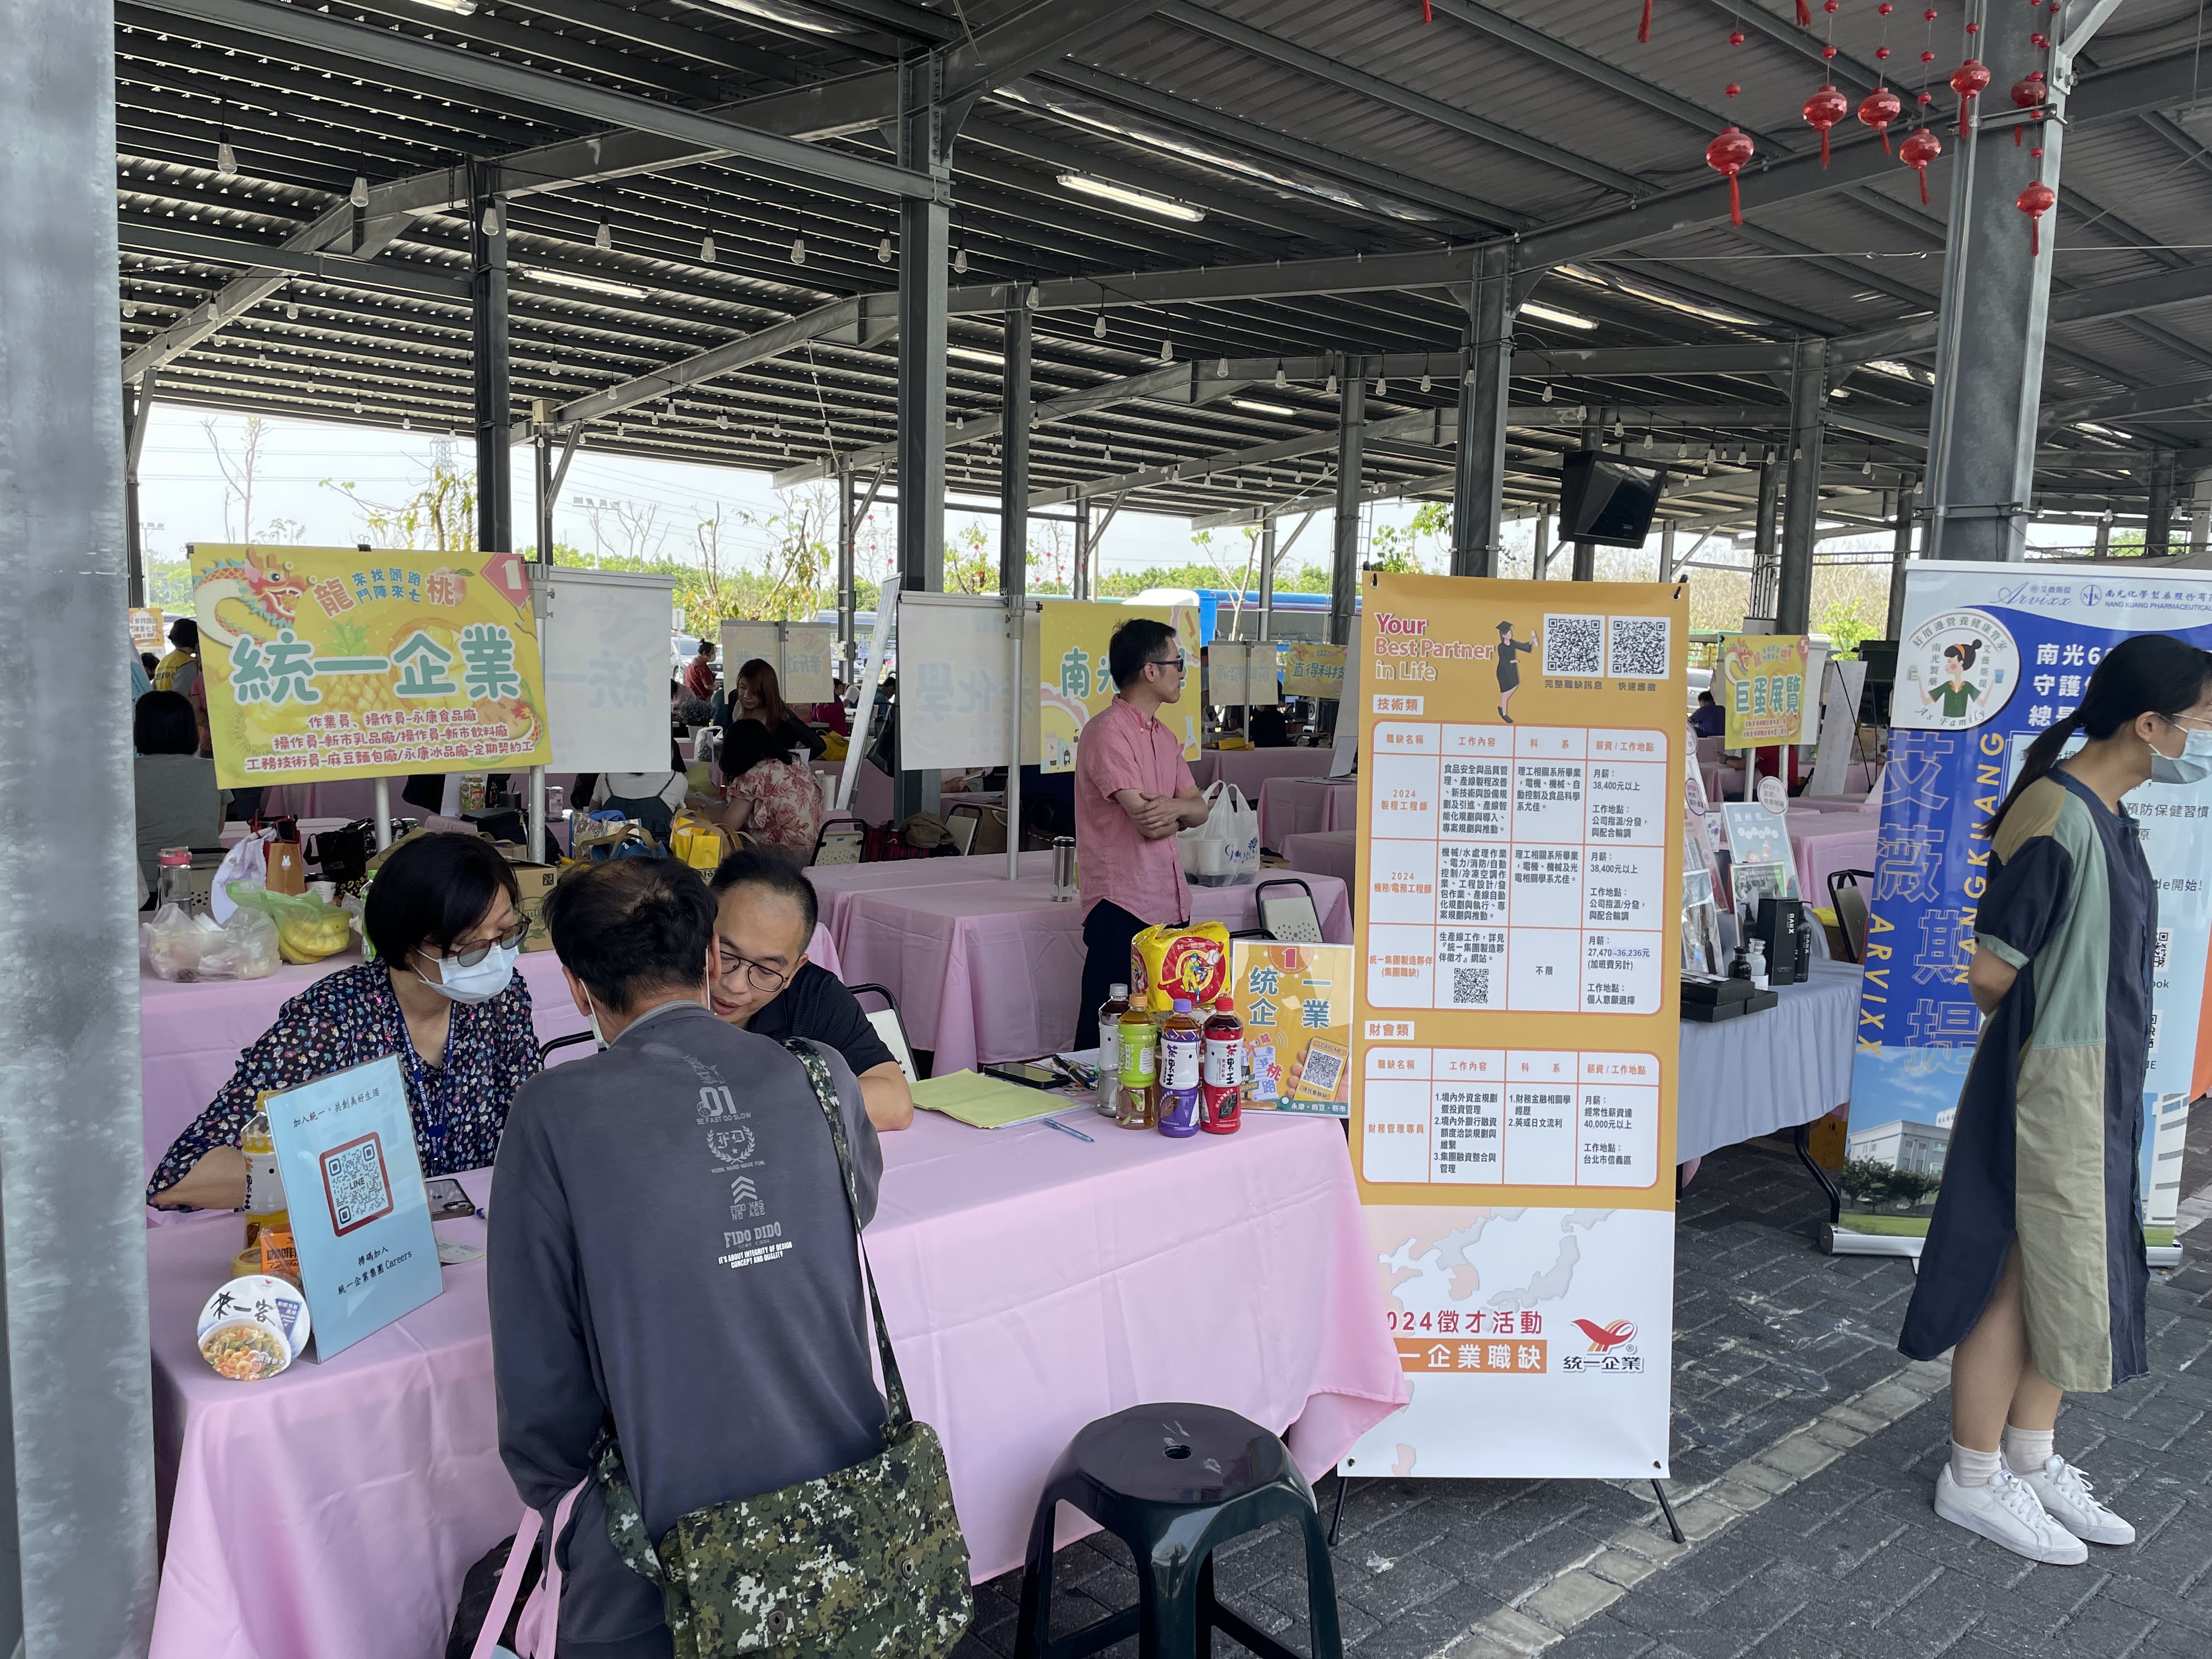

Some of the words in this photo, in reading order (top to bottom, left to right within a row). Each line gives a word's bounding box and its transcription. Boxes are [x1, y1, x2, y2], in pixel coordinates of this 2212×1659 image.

[352, 568, 421, 587] 來找頭路
[501, 560, 520, 590] 1
[427, 575, 455, 606] 桃
[313, 577, 355, 618] 龍
[2149, 603, 2212, 612] PHARMACEUTICAL
[1375, 613, 1428, 635] Your
[1374, 637, 1417, 657] Best
[1420, 641, 1494, 660] Partner
[1801, 639, 1809, 653] 5
[230, 625, 521, 703] 統一企業
[1928, 643, 1942, 686] 南光製藥
[1375, 661, 1395, 680] in
[1398, 662, 1437, 681] Life
[1544, 680, 1602, 690] 完整職缺訊息
[1618, 681, 1656, 692] 快速應徵
[2033, 674, 2092, 697] 守護
[1736, 675, 1801, 714] 巨蛋展覽
[1378, 697, 1418, 712] 技術類
[308, 710, 477, 730] 作業員、操作員-永康食品廠
[1386, 733, 1424, 745] 職缺名稱
[1458, 736, 1496, 747] 工作內容
[1444, 764, 1508, 775] 食品安全與品質管
[1517, 767, 1581, 778] 理工相關系所畢業
[1593, 769, 1615, 779] 月薪：
[1443, 776, 1507, 787] 理、產線製程改善
[1593, 781, 1640, 792] 38,400元以上
[1392, 789, 1417, 799] 2024
[1446, 787, 1507, 799] 、新技術與設備規
[1517, 791, 1580, 802] 動控制及食品科學
[1381, 800, 1427, 812] 製程工程師
[1443, 799, 1507, 811] 劃及引進、產線智
[1516, 802, 1547, 812] 系尤佳。
[1593, 804, 1629, 815] 工作地點：
[1443, 811, 1504, 822] 能化規劃與導入、
[1442, 823, 1504, 834] 專案規劃與推動。
[1592, 827, 1632, 838] 與配合輪調
[1441, 848, 1507, 859] 機械/水處理作業
[1515, 850, 1578, 861] 理工相關系所畢業
[1591, 851, 1612, 861] 月薪：
[1441, 868, 1506, 880] 控制/冷凍空調作
[1590, 864, 1638, 874] 38,400元以上
[1391, 872, 1415, 881] 2024
[1514, 873, 1576, 884] 電相關學系尤佳。
[1374, 882, 1432, 894] 機務/電務工程師
[1441, 879, 1506, 890] 業、工程設計/發
[1441, 889, 1506, 901] 包作業、產線自動
[1590, 887, 1628, 898] 工作地點：
[1440, 900, 1506, 911] 化規劃與執行、專
[1440, 911, 1494, 922] 案規劃與推動。
[1589, 911, 1629, 922] 與配合輪調
[1440, 932, 1505, 943] 生產線工作，詳見
[1589, 936, 1610, 945] 月薪：
[1283, 948, 1296, 968] 1
[1369, 955, 1433, 966] 統一集團製造夥伴
[1536, 966, 1553, 976] 不限
[1588, 960, 1633, 971] (加班費另計)
[1382, 967, 1419, 978] (集團職缺)
[1587, 983, 1624, 993] 工作地點：
[1587, 995, 1635, 1005] 個人意願選擇
[1369, 1024, 1409, 1037] 財會類
[1260, 1032, 1271, 1045] 龍
[1317, 1041, 1333, 1051] SCAN
[1378, 1059, 1415, 1070] 職缺名稱
[1449, 1061, 1487, 1071] 工作內容
[1266, 1063, 1283, 1081] 桃
[699, 1086, 737, 1116] 01
[1436, 1092, 1497, 1103] 1.境內外資金規劃
[1509, 1094, 1571, 1104] 1.財務金融相關學
[1585, 1096, 1606, 1105] 月薪：
[1291, 1103, 1346, 1113] 永康、麻豆、新市
[1441, 1105, 1481, 1114] 暨投資管理
[1515, 1106, 1531, 1115] 經歷
[1584, 1107, 1632, 1118] 經常性薪資達
[733, 1112, 752, 1121] SLOW
[1435, 1116, 1497, 1127] 2.境內外銀行融資
[1509, 1118, 1562, 1128] 2.英或日文流利
[1584, 1119, 1632, 1130] 40,000元以上
[1368, 1123, 1424, 1135] 財務管理專員
[1441, 1128, 1496, 1138] 額度洽談規劃與
[1440, 1140, 1456, 1149] 維繫
[1584, 1142, 1621, 1153] 工作地點：
[1434, 1152, 1496, 1162] 3.集團融資整合與
[1583, 1155, 1632, 1165] 台北市信義區
[1440, 1164, 1455, 1173] 管理
[349, 1177, 365, 1190] LINE
[731, 1211, 743, 1221] NO
[724, 1229, 752, 1249] FIDO
[753, 1221, 782, 1240] DIDO
[728, 1251, 744, 1262] ABOUT
[744, 1246, 768, 1259] INTEGRITY
[775, 1241, 793, 1251] DESIGN
[385, 1250, 412, 1269] Careers
[731, 1259, 753, 1269] CONCEPT
[764, 1251, 783, 1261] QUALITY
[210, 1291, 276, 1327] 來一客
[1387, 1310, 1543, 1334] 024徵才活動
[1398, 1344, 1541, 1370] 一企業職缺
[1563, 1355, 1642, 1371] 統一企業
